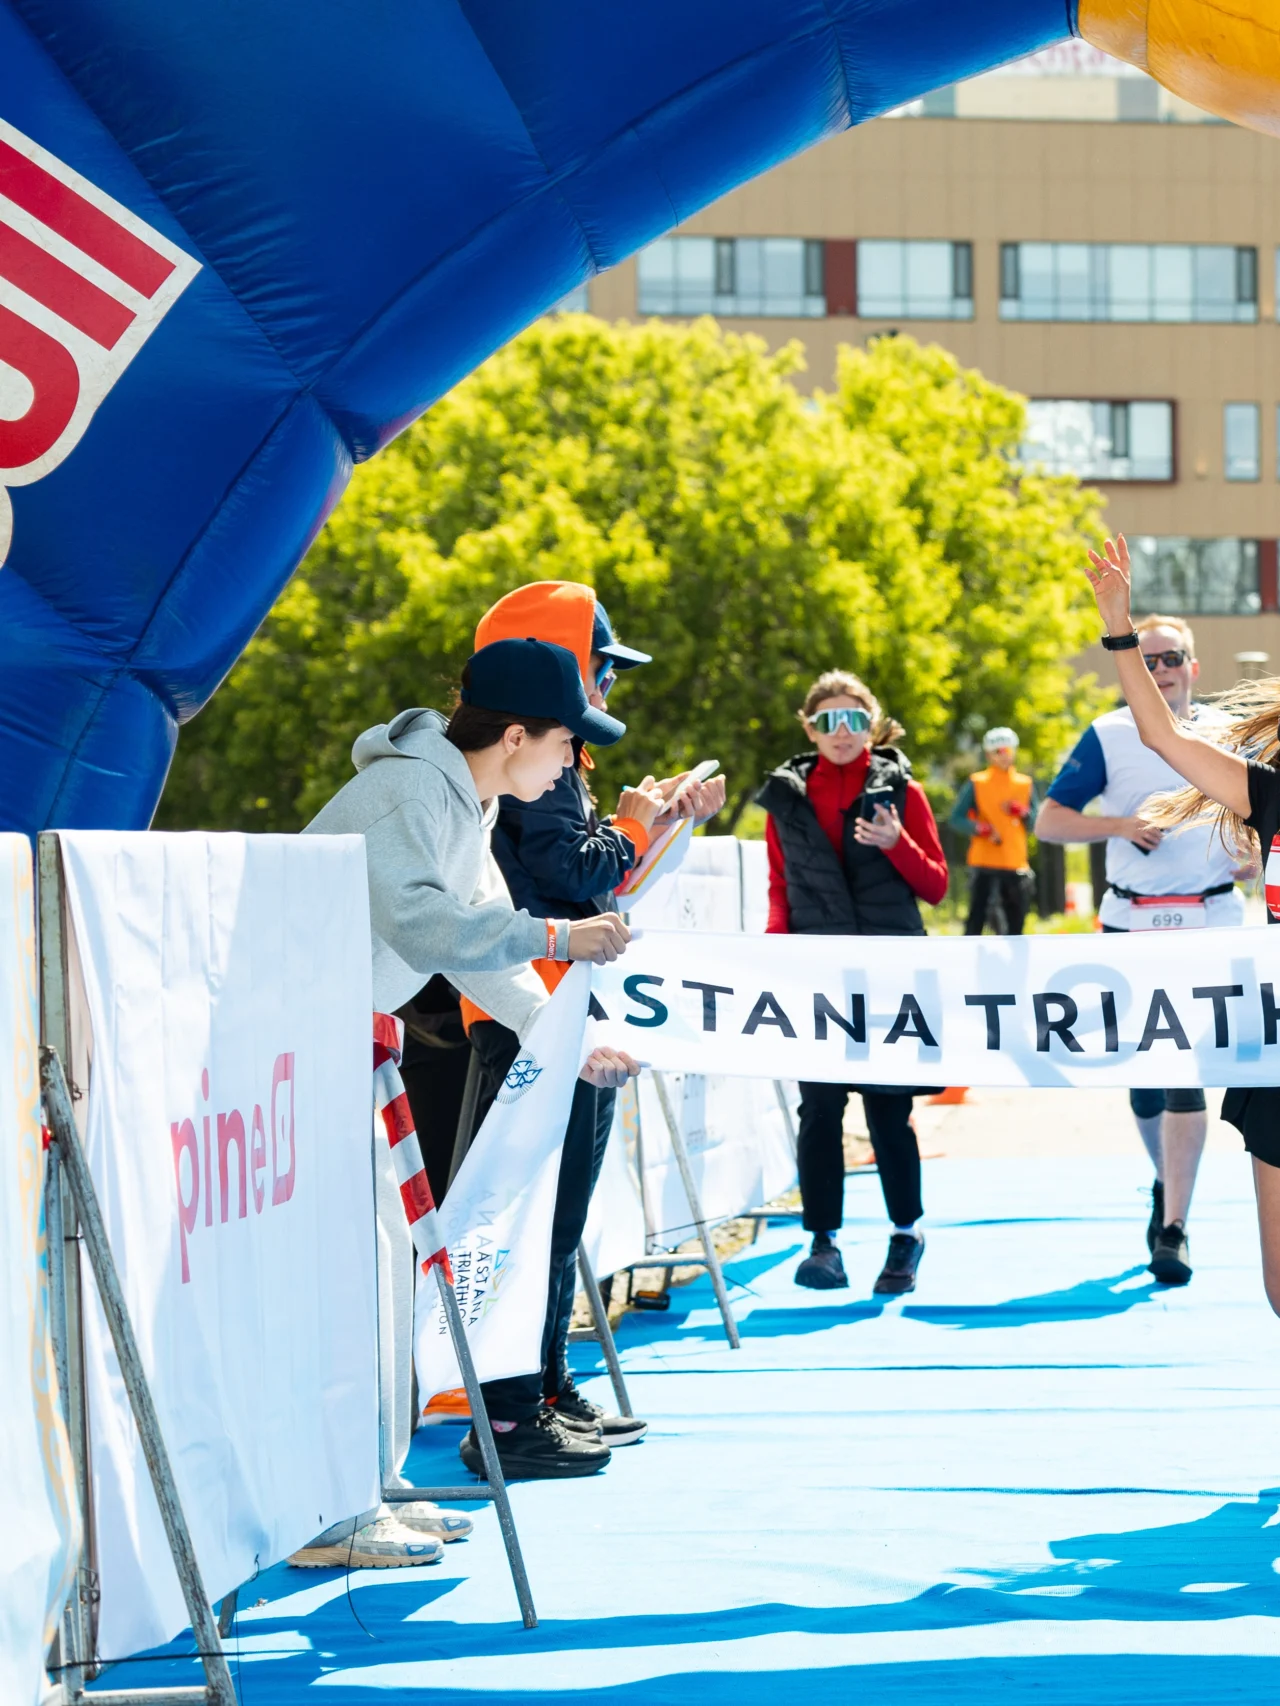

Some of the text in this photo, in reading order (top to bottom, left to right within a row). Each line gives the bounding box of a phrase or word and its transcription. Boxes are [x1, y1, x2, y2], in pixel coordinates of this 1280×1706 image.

[1152, 912, 1184, 928] 699
[456, 1251, 472, 1323] TRIATHLO
[468, 1251, 492, 1327] ASTANA
